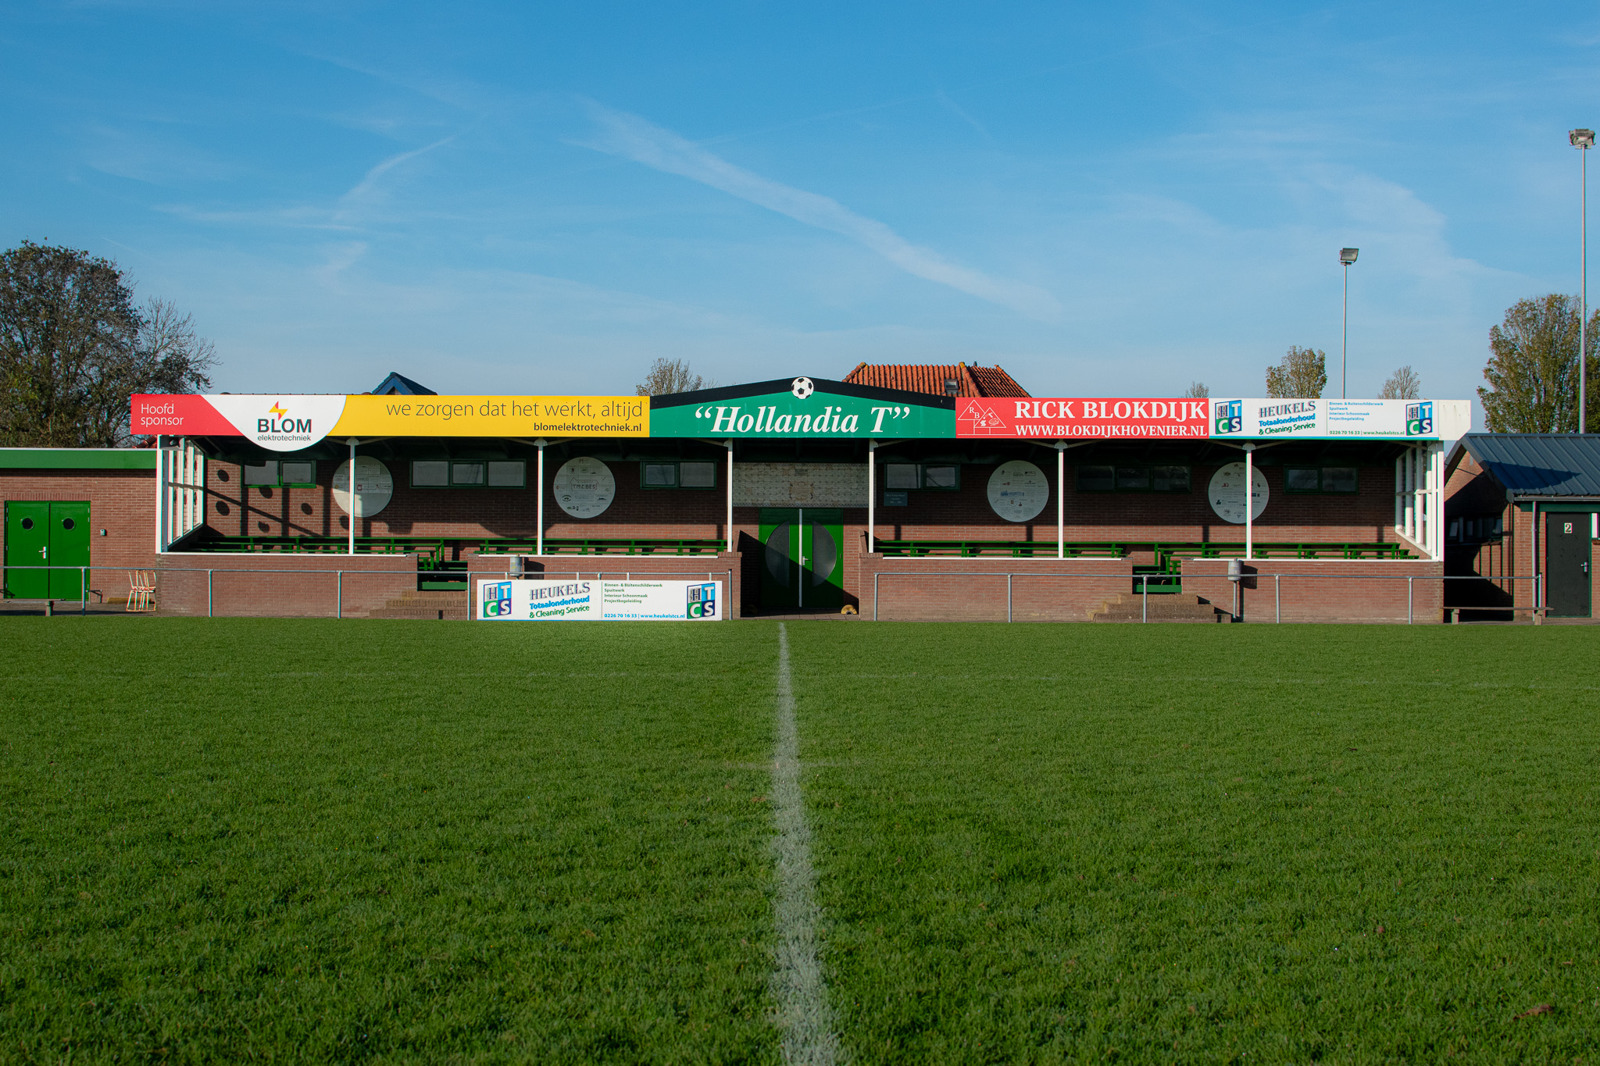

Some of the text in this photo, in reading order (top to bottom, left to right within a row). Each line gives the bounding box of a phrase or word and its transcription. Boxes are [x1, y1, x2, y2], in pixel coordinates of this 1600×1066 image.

[140, 403, 175, 414] Hoofd
[386, 400, 643, 421] we zorgen dat het werkt, altijd
[1014, 401, 1207, 422] RICK BLOKDIJK
[1259, 401, 1316, 418] HEUKELS
[140, 416, 184, 428] sponsor
[257, 418, 312, 434] BLOM
[1259, 413, 1316, 427] Totaalonderhoud
[533, 422, 642, 432] blomelektrotechniek.nl
[1015, 425, 1208, 438] WWW.BLOKDIJKHOVENIER.NL
[1265, 424, 1292, 434] Cleaning
[1293, 423, 1316, 431] Service
[1565, 524, 1572, 532] 2
[530, 582, 590, 600] HEUKELS
[530, 595, 590, 610] Totaalonderhoud
[536, 608, 565, 618] Cleaning
[566, 605, 590, 613] Service
